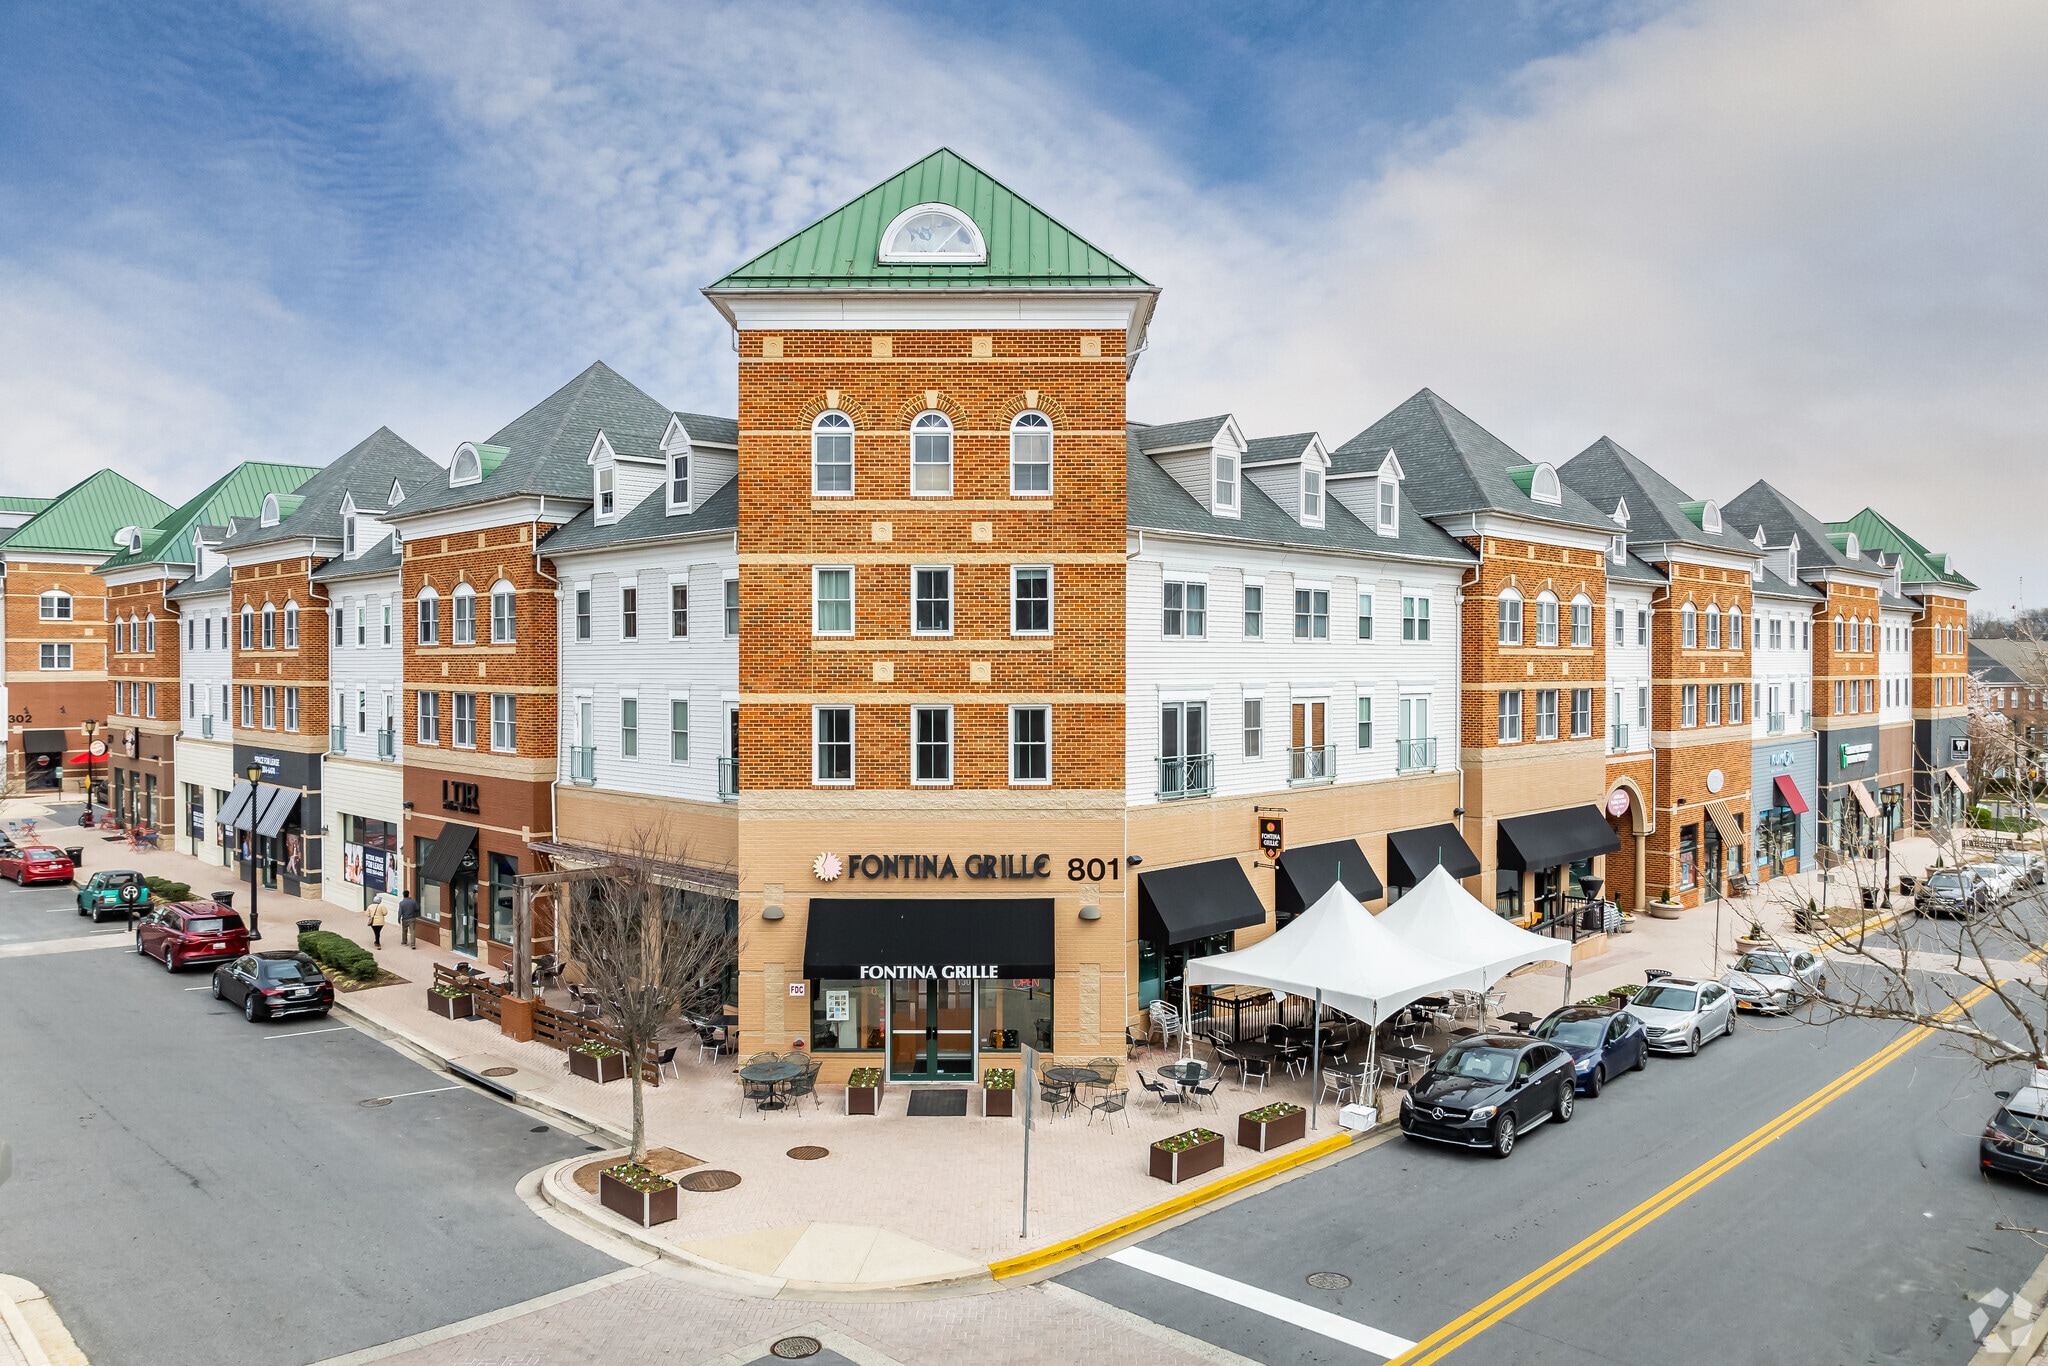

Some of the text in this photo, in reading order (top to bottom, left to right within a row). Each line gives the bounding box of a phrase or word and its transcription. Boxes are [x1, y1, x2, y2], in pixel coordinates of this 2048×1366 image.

[8, 715, 32, 723] 302
[848, 853, 1051, 879] FONTINA GRILLE
[1067, 857, 1120, 881] 801
[860, 965, 998, 979] FONTINA GRILLE
[1012, 979, 1040, 987] OPEN
[790, 985, 804, 994] FDC
